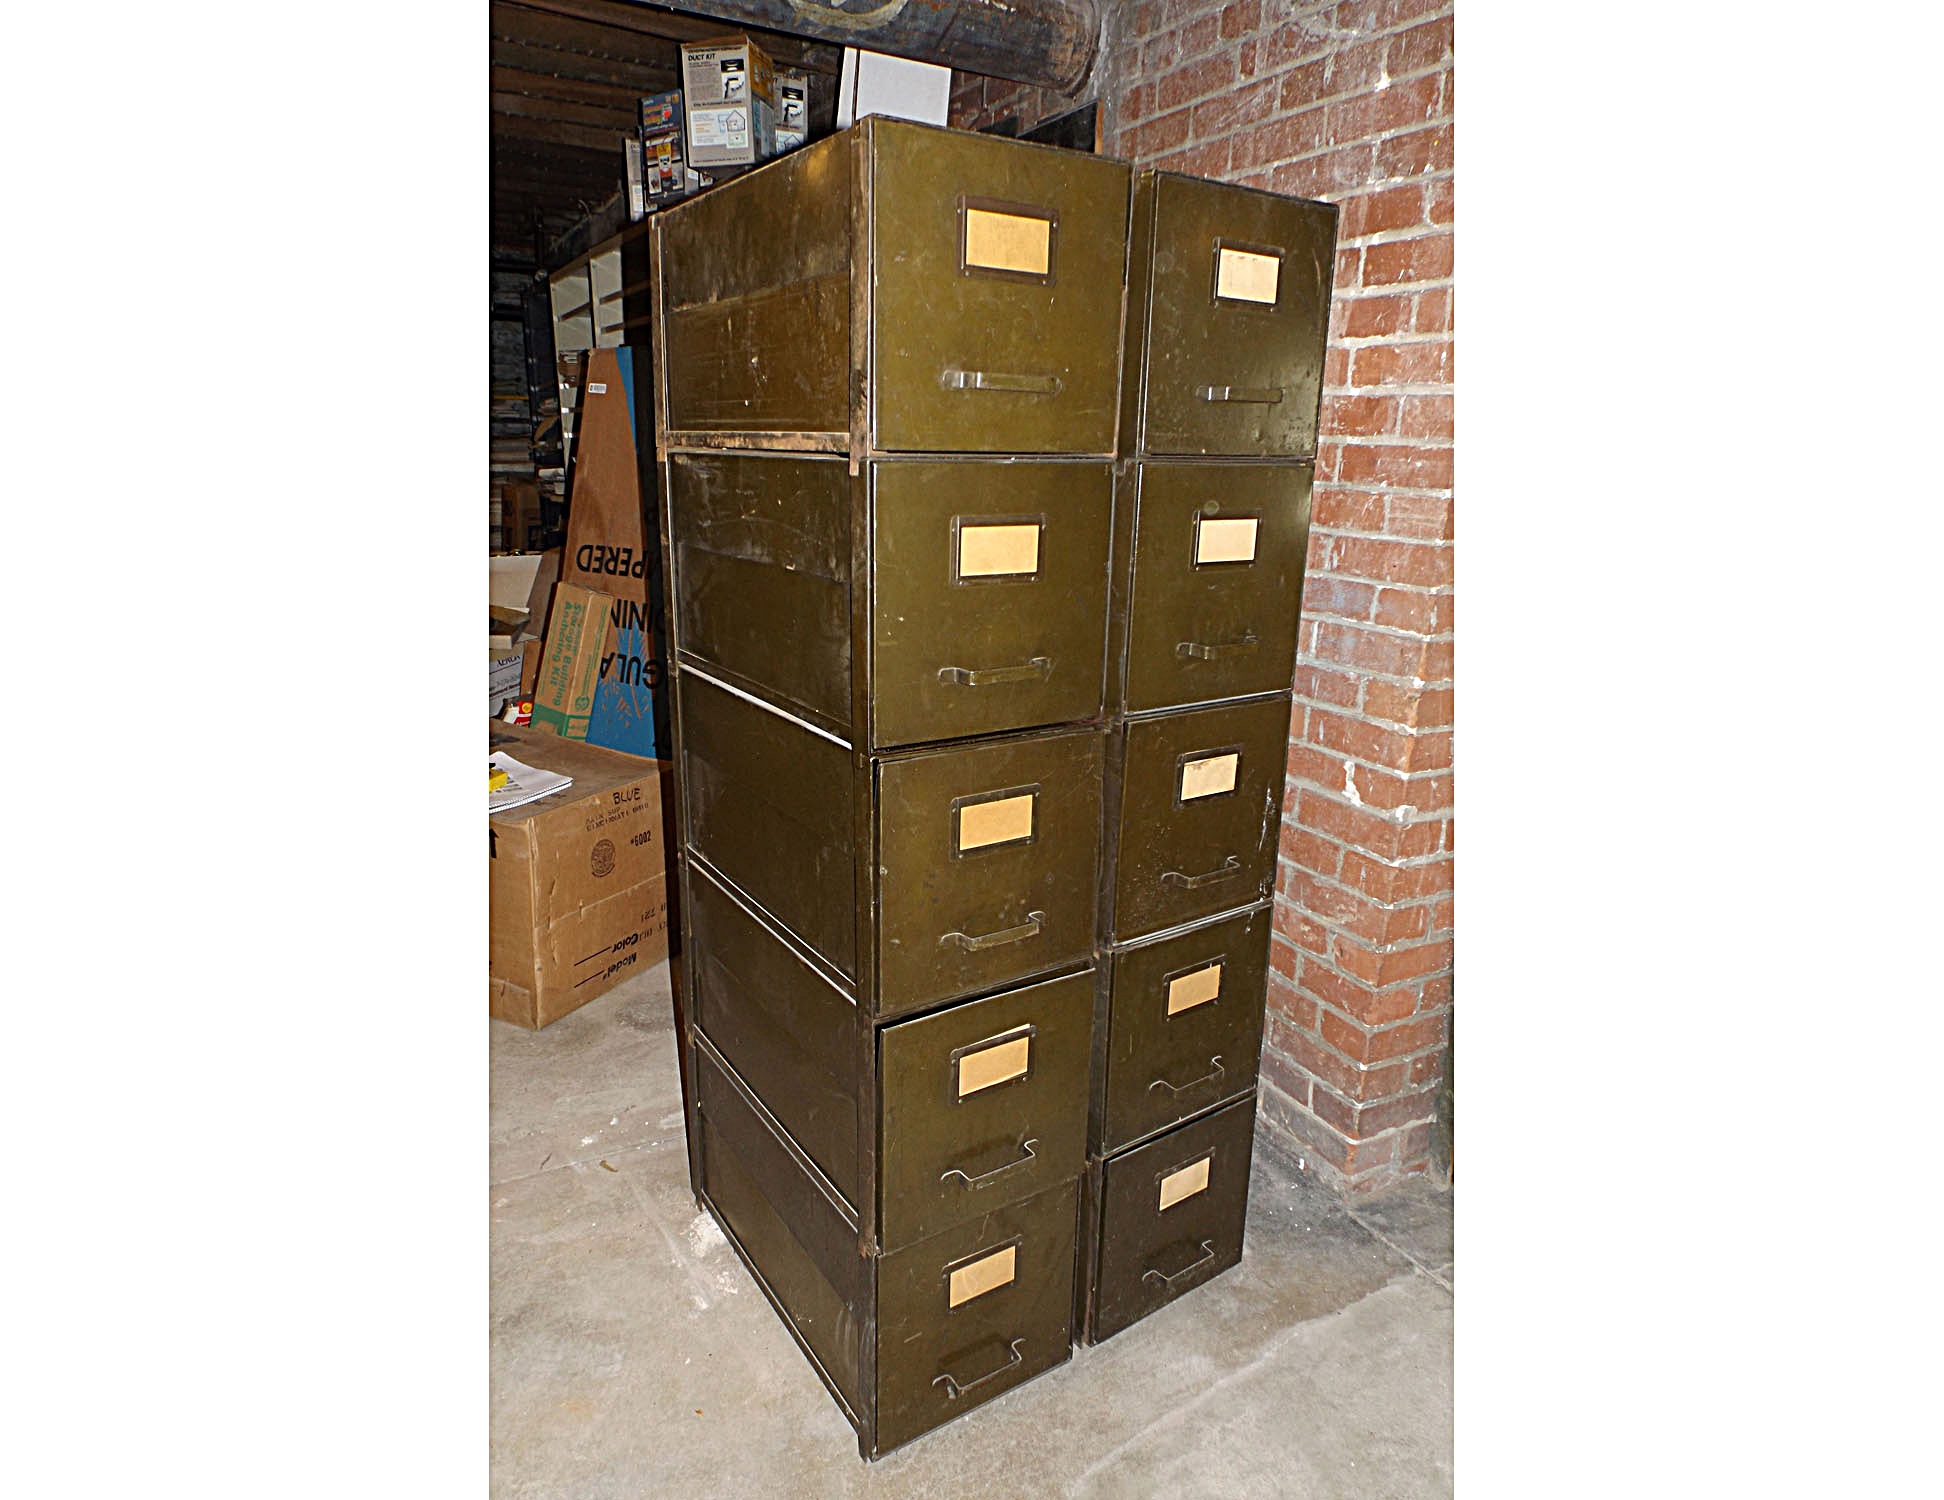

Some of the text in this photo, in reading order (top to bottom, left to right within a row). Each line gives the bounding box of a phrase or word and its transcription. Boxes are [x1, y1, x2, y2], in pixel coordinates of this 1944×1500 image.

[688, 53, 716, 62] DUCT KIT
[576, 544, 648, 578] PERED
[552, 601, 574, 663] Anchoring
[565, 602, 583, 651] Storage
[549, 666, 560, 688] Kit
[552, 655, 573, 706] Building
[600, 653, 660, 689] GULA
[612, 787, 641, 805] BLUE
[611, 932, 639, 953] Color
